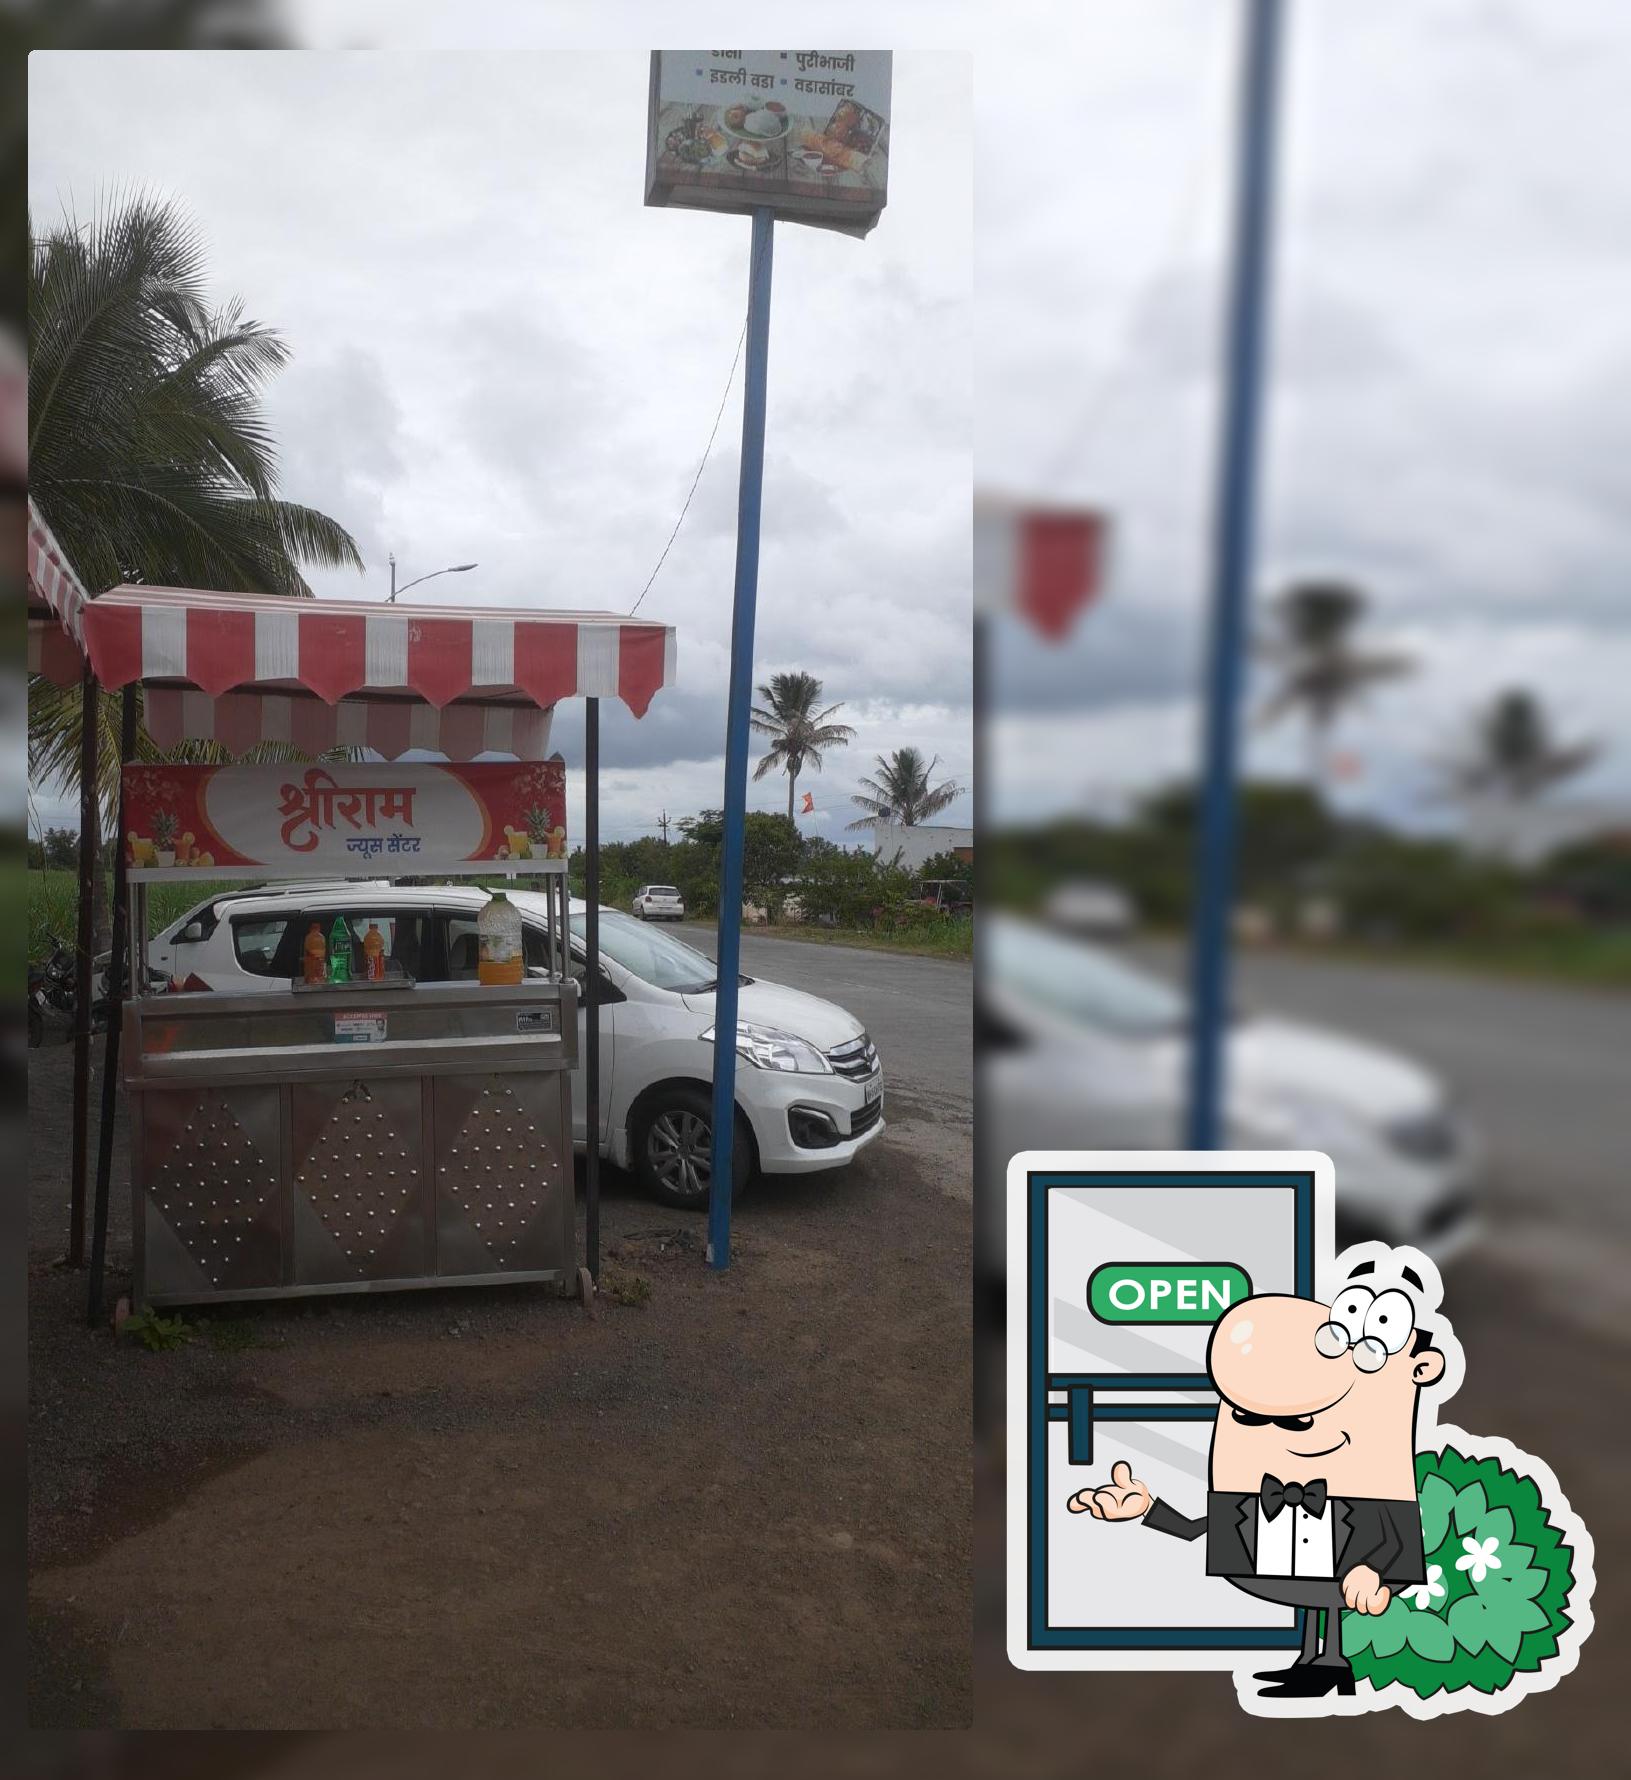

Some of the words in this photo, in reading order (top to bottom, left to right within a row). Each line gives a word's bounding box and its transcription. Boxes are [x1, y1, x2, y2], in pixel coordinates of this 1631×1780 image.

[795, 50, 855, 72] पुरीभाजी
[709, 67, 747, 86] इडली
[750, 73, 775, 89] वडा
[277, 768, 417, 852] श्रीराम
[346, 837, 384, 860] ज्यूस
[387, 833, 422, 853] सेंटर
